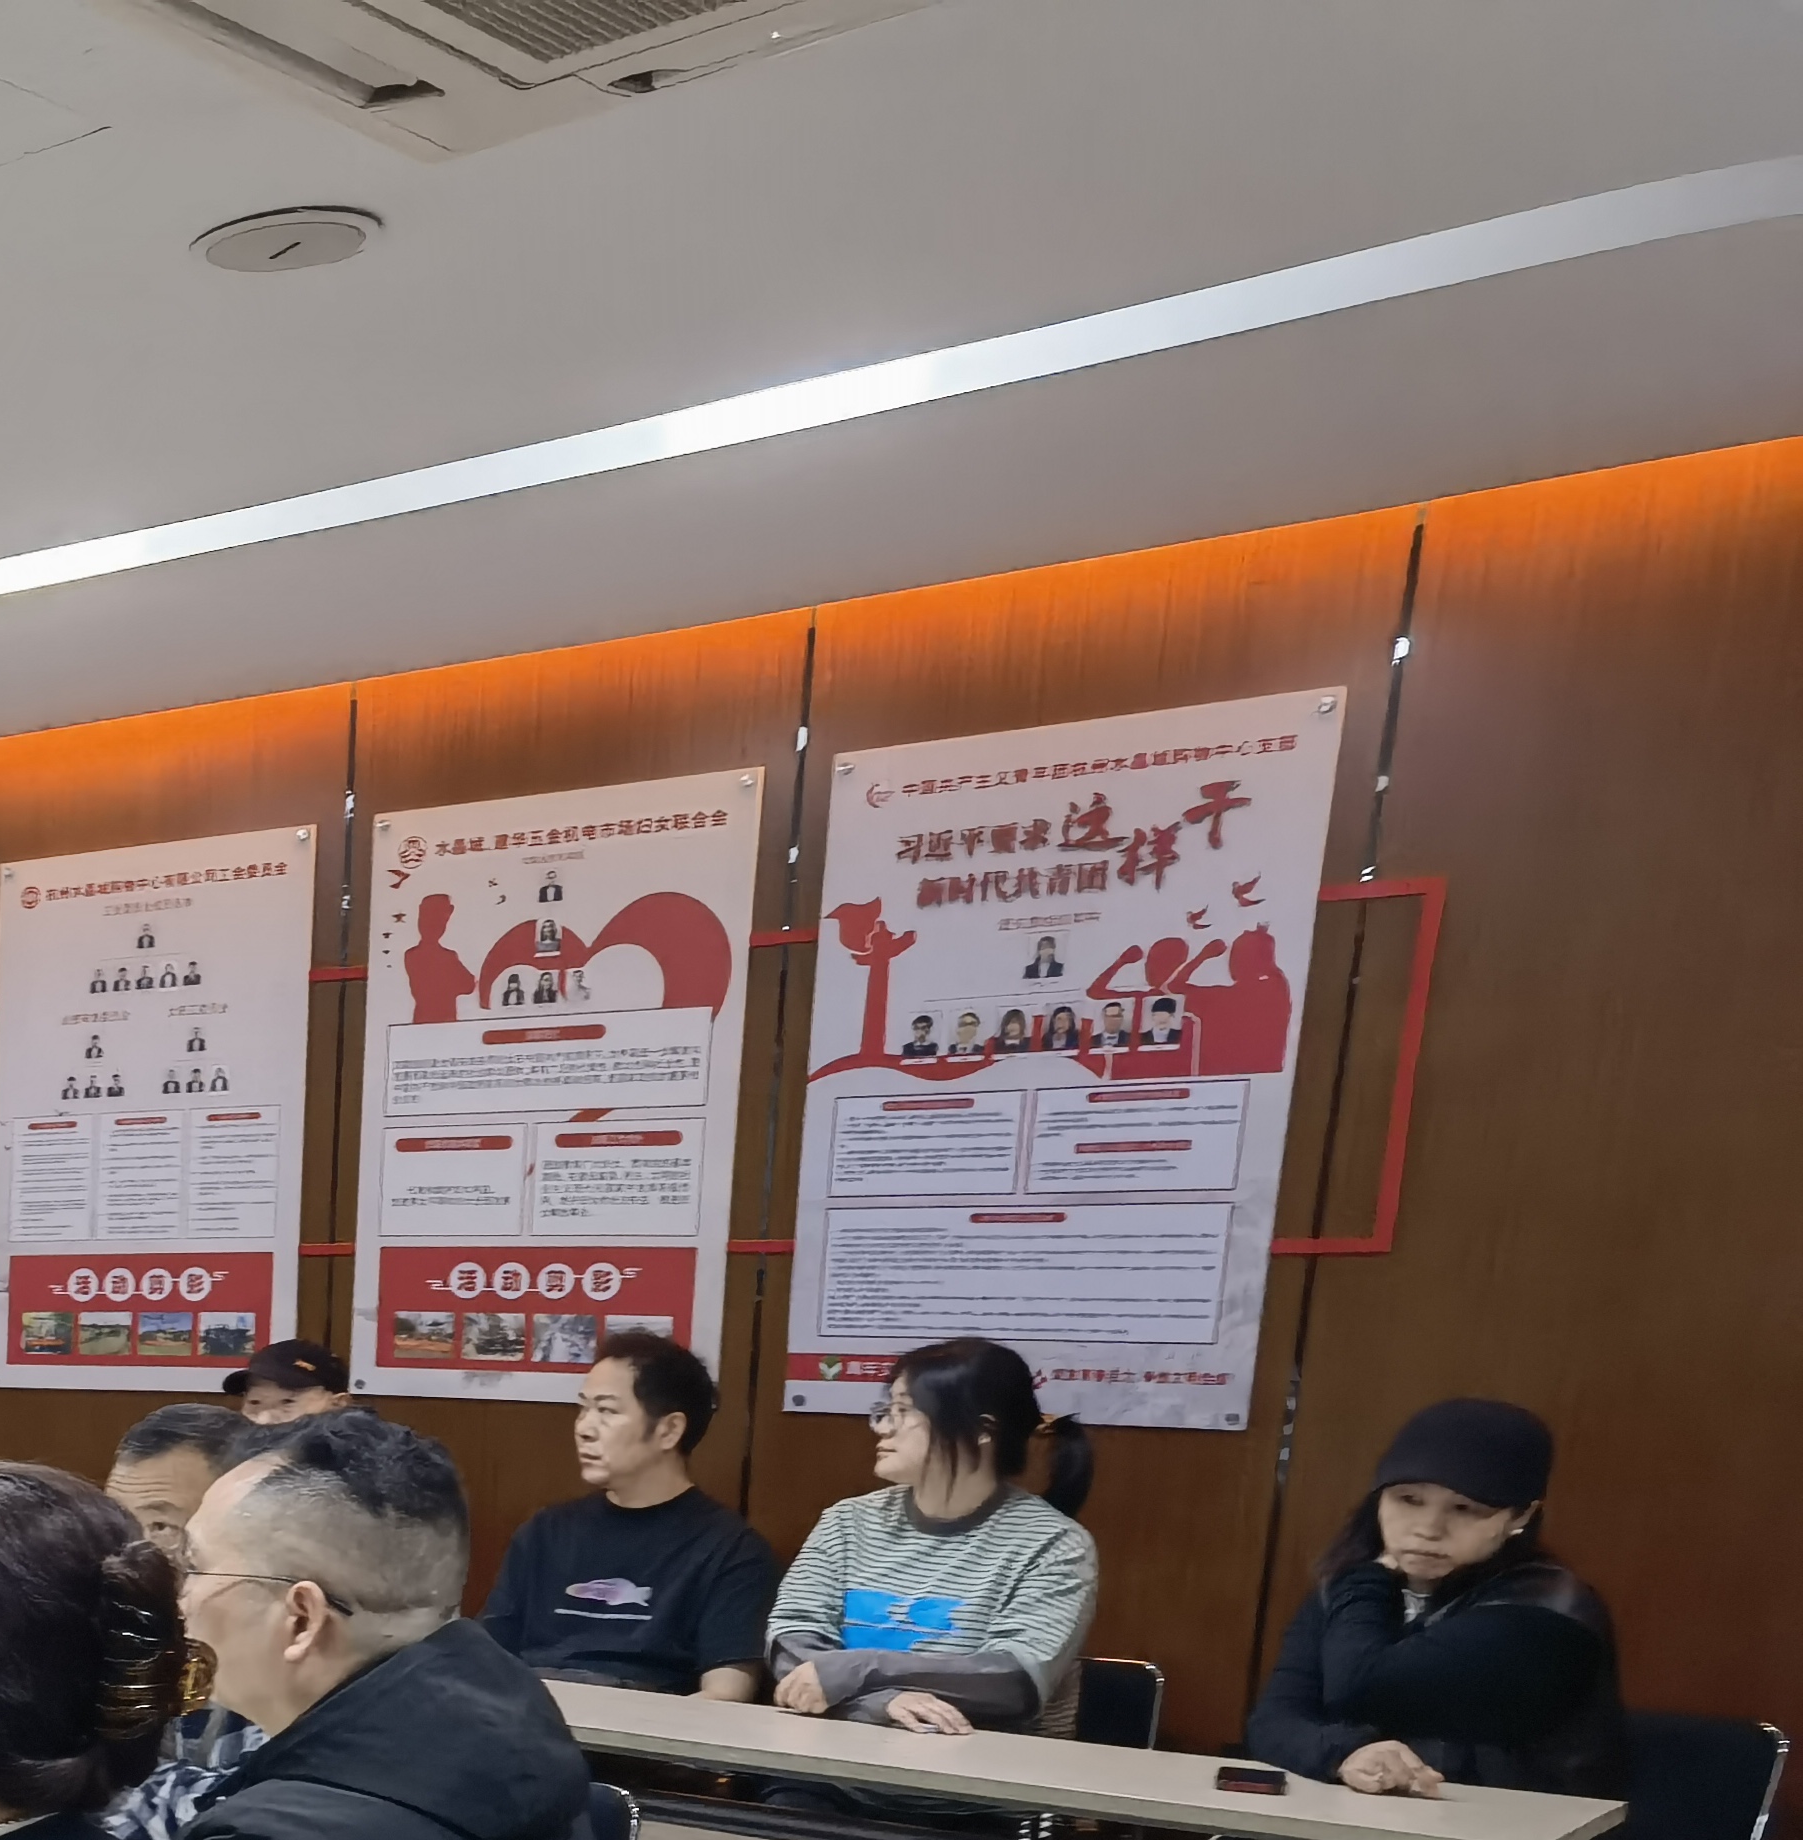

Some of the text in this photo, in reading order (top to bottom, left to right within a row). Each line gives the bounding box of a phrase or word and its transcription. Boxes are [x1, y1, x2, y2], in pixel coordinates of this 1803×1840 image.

[895, 818, 1052, 863] 习近平要求
[916, 859, 1110, 908] 新时代共青团
